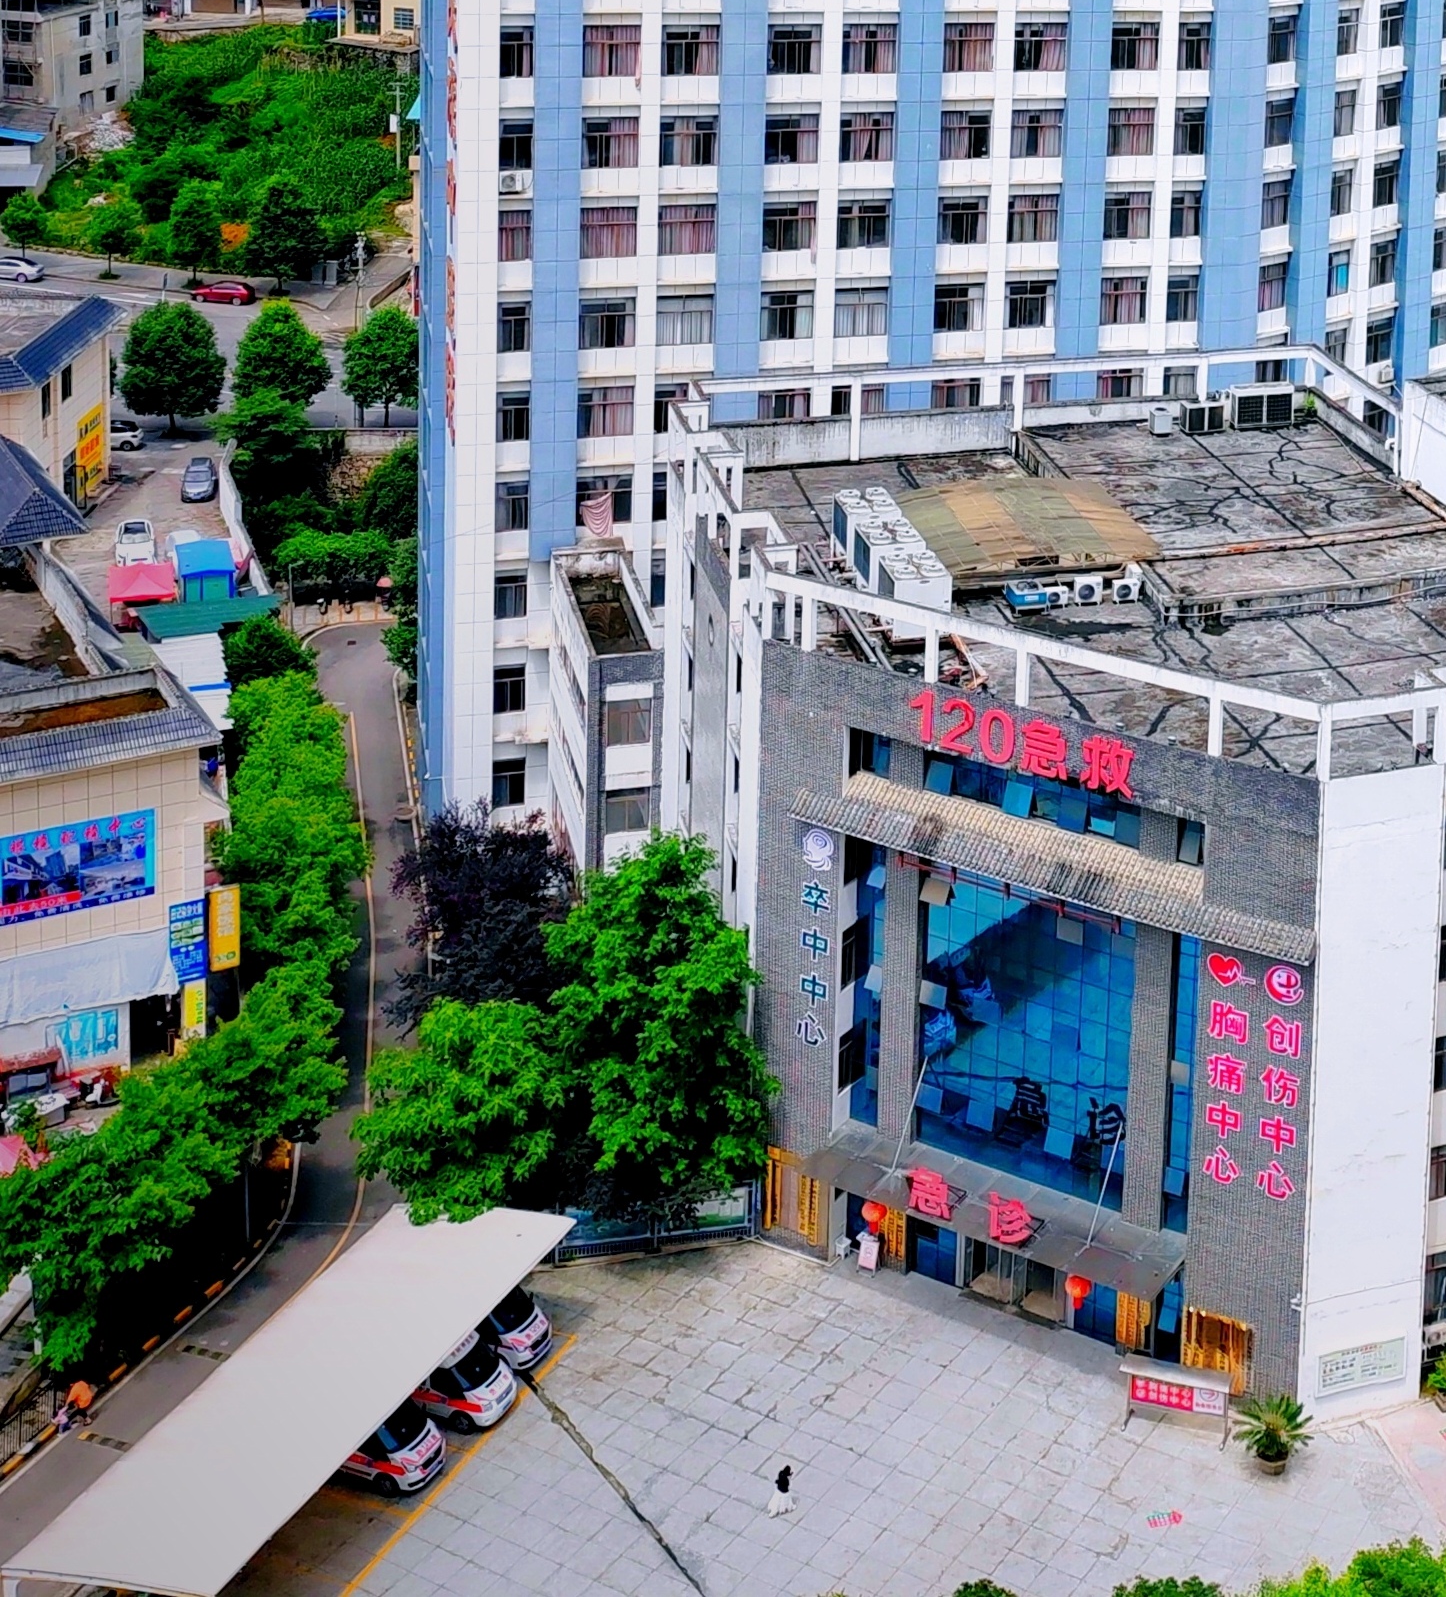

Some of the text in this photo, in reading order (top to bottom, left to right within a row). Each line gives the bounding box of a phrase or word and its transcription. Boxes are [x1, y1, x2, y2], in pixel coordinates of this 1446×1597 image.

[909, 689, 1136, 800] 120急救
[795, 879, 831, 1048] 卒中中心
[1203, 1001, 1251, 1186] 胸痛中心
[1256, 1013, 1304, 1202] 创伤中心
[908, 1166, 1035, 1246] 急诊
